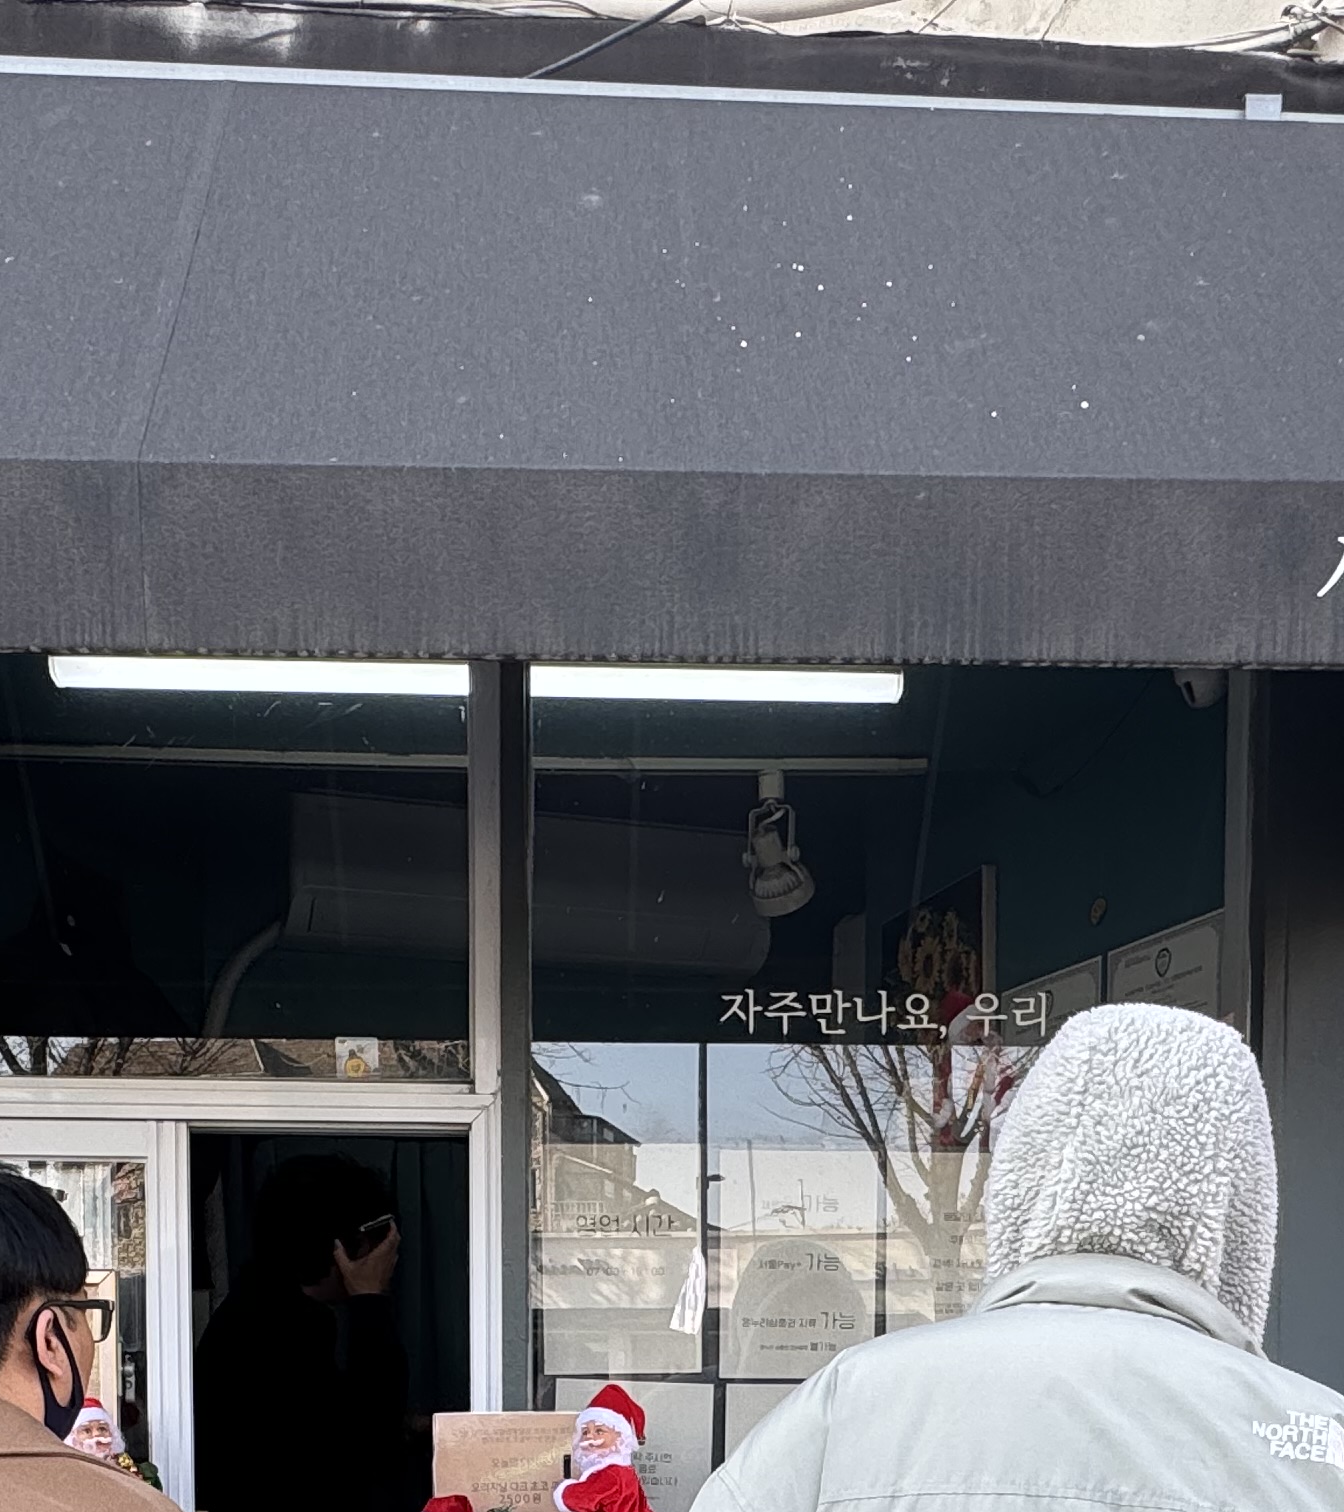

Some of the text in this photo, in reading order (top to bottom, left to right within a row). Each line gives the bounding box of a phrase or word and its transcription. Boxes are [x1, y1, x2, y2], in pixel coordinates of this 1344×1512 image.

[718, 990, 949, 1037] 자주만나요,
[965, 991, 1049, 1037] 우리
[632, 1214, 676, 1237] 시간
[805, 1252, 841, 1272] 가능
[820, 1311, 857, 1330] 가능
[1286, 1410, 1330, 1430] THE
[1252, 1420, 1329, 1446] NORTH
[1269, 1440, 1327, 1462] FACE
